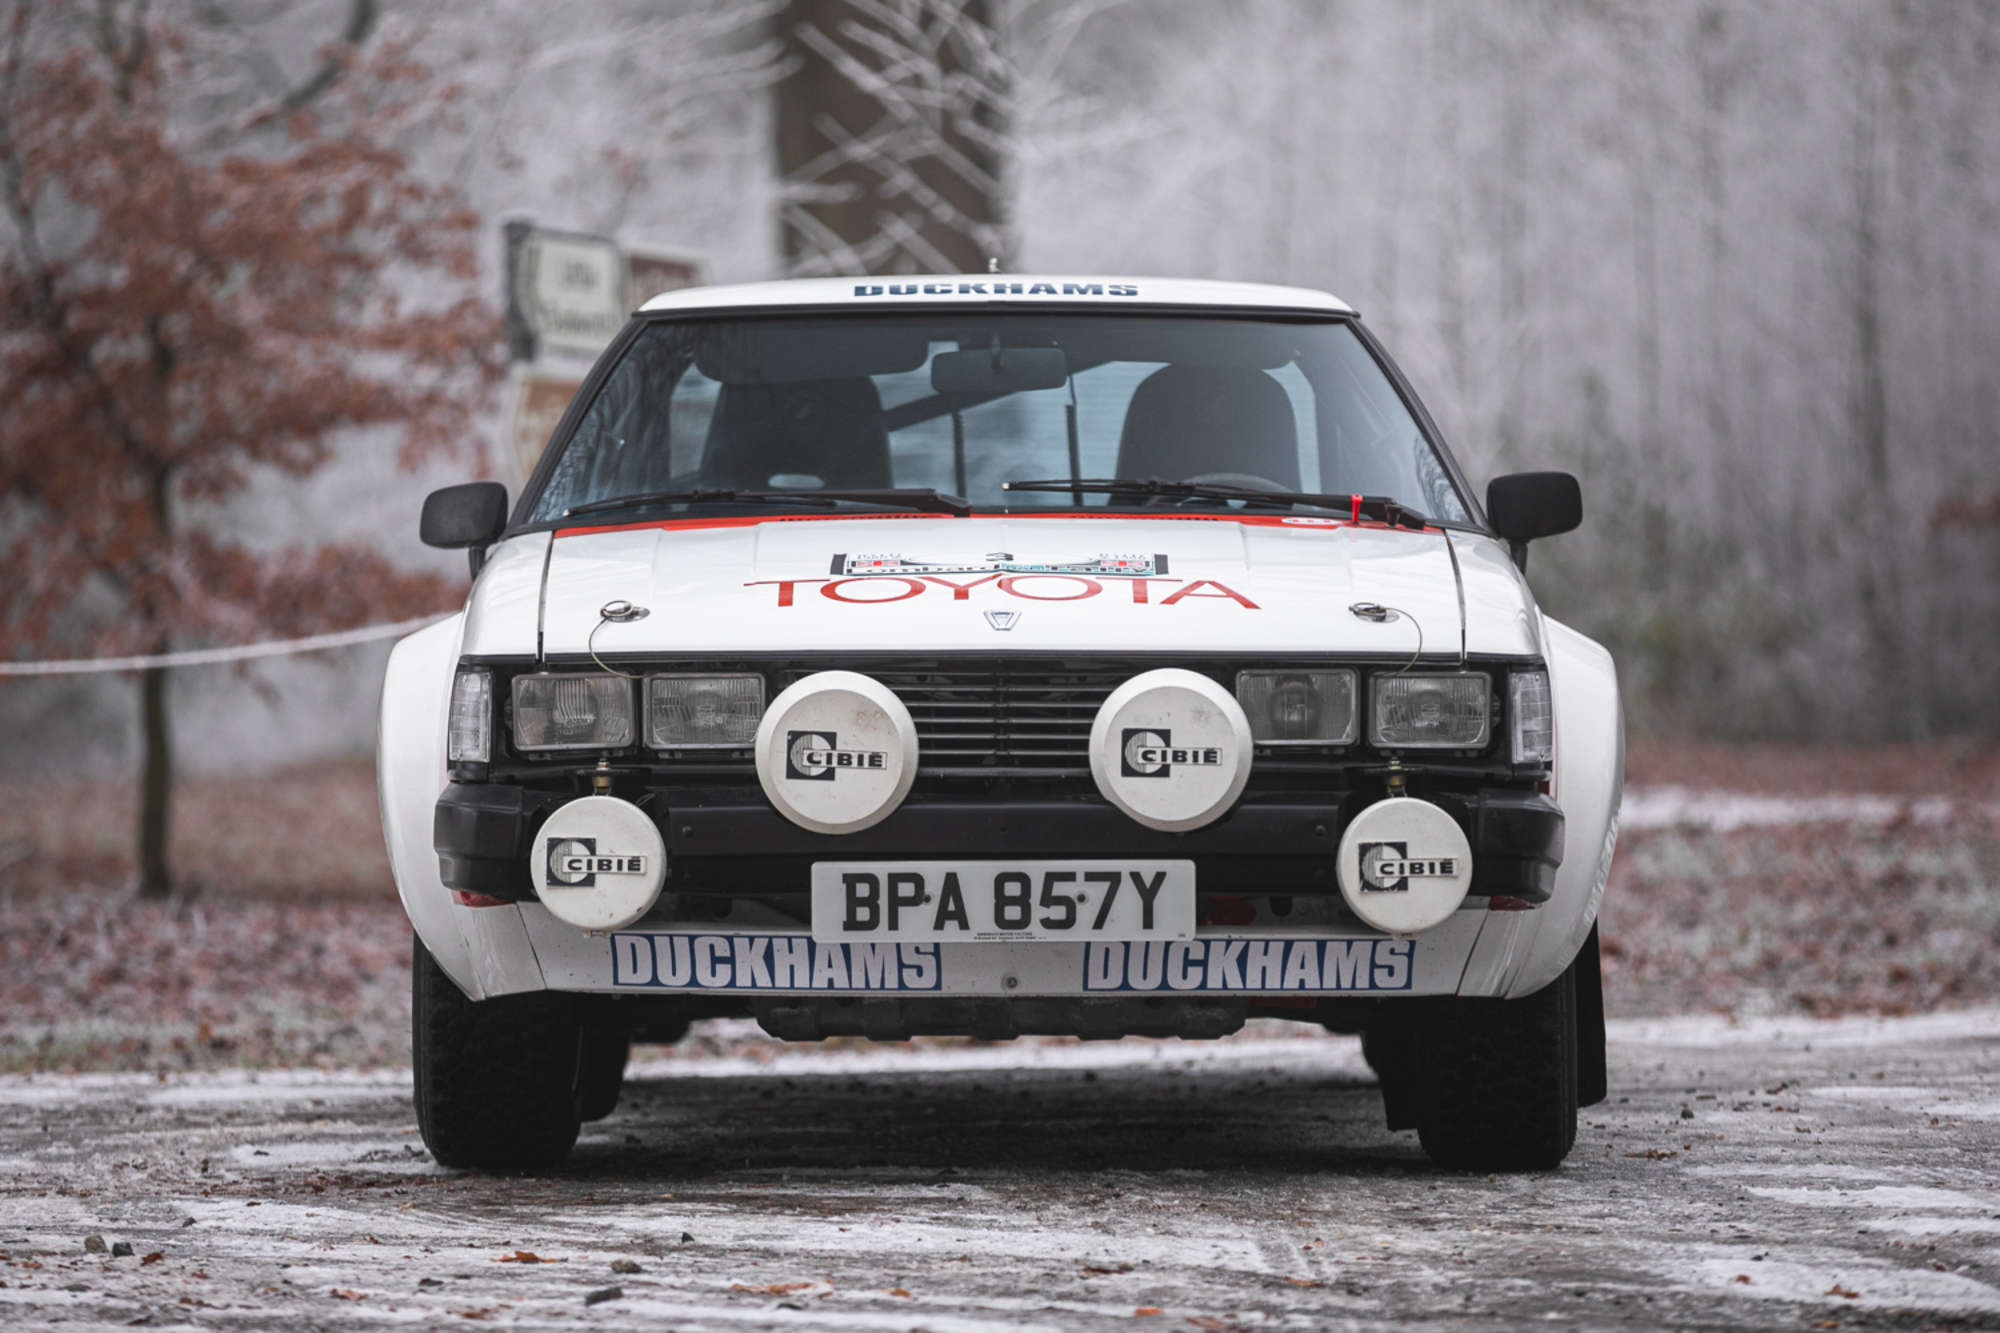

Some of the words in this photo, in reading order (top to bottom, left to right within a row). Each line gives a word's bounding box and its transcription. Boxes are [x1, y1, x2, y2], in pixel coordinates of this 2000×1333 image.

[854, 283, 1139, 297] DUCKHAMS
[744, 573, 1261, 609] TOYOTA
[843, 872, 970, 931] BPA
[993, 871, 1167, 931] 857Y
[615, 935, 938, 990] DUCKHAMS
[1087, 939, 1411, 990] DUCKHAMS
